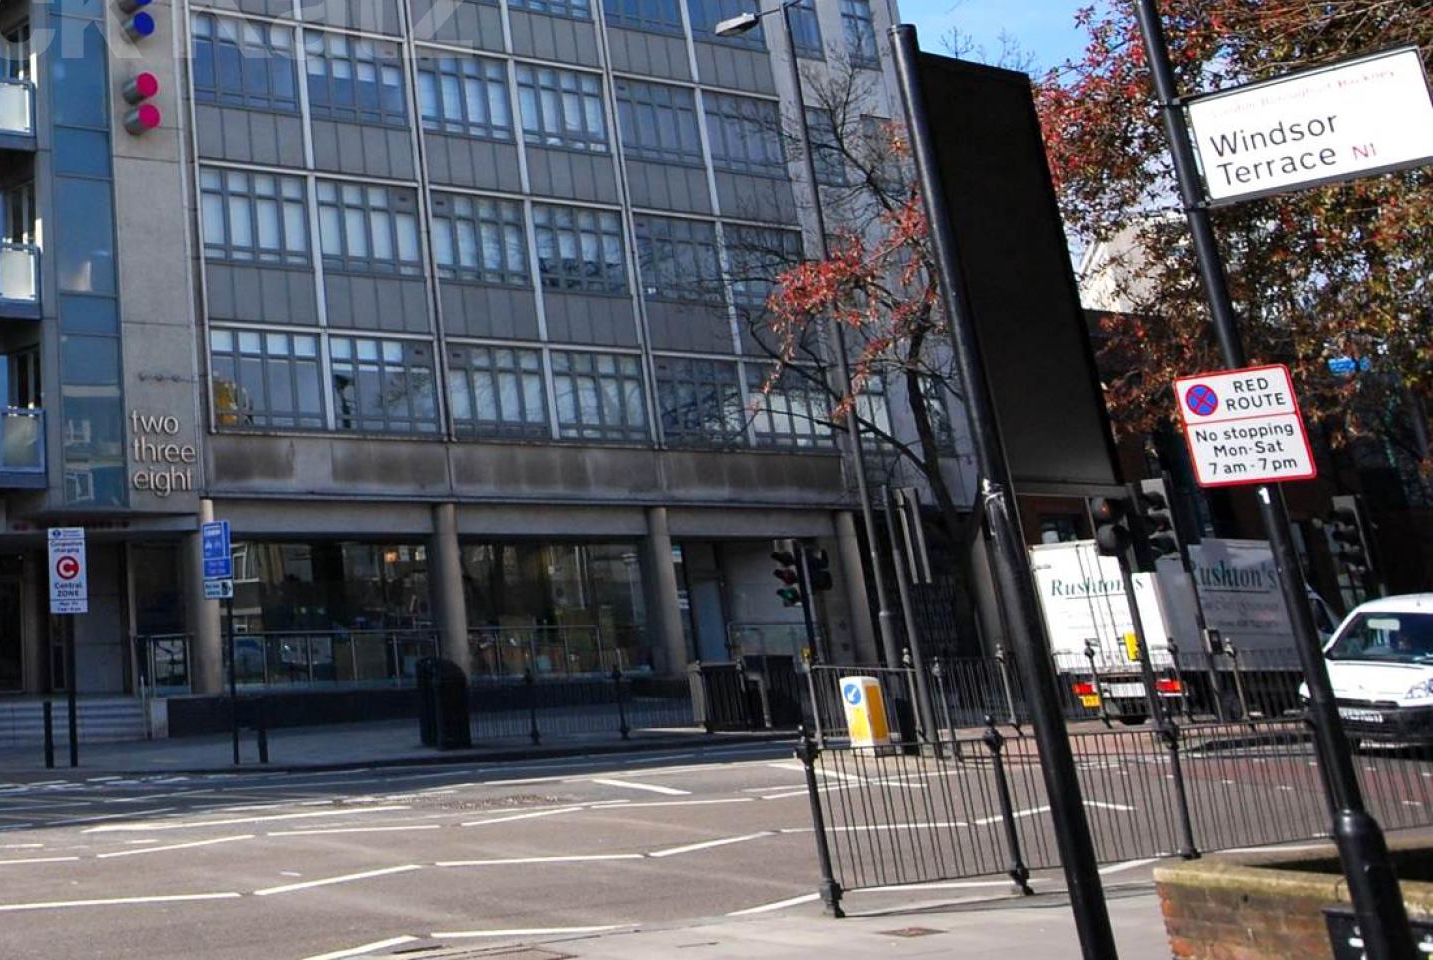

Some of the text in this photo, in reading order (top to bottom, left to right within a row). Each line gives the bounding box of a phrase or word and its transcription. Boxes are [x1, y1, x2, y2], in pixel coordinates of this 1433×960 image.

[1209, 114, 1338, 157] Windsor
[1217, 147, 1337, 186] Terrace
[1232, 377, 1269, 393] RED
[1226, 392, 1287, 411] ROUTE
[131, 410, 179, 435] two
[1195, 423, 1295, 443] No stopping
[134, 436, 196, 462] three
[134, 465, 192, 497] eight
